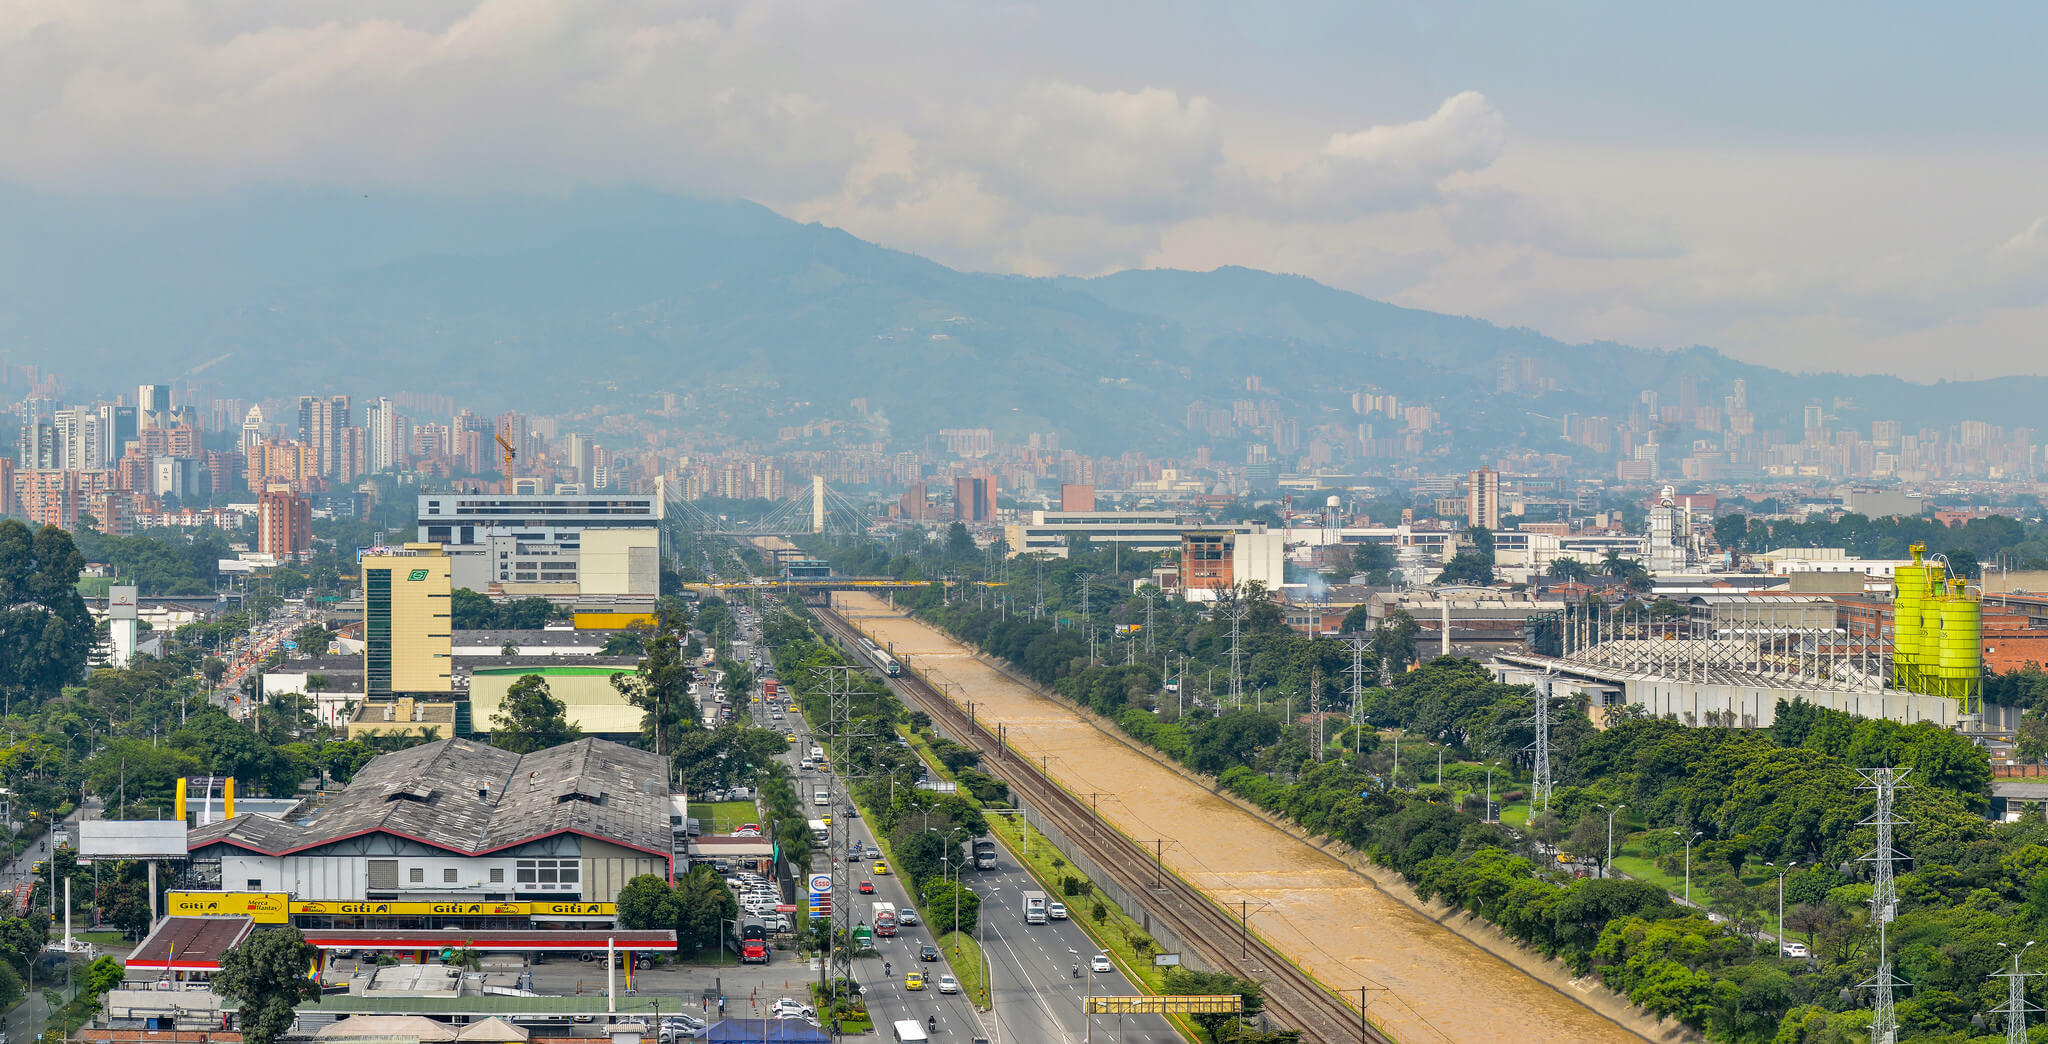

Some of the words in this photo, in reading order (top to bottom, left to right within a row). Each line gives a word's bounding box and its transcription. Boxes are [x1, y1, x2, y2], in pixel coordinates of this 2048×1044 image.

[180, 902, 204, 910] Giti
[341, 904, 371, 913] Giti
[433, 904, 463, 913] Giti
[552, 904, 582, 913] Giti
